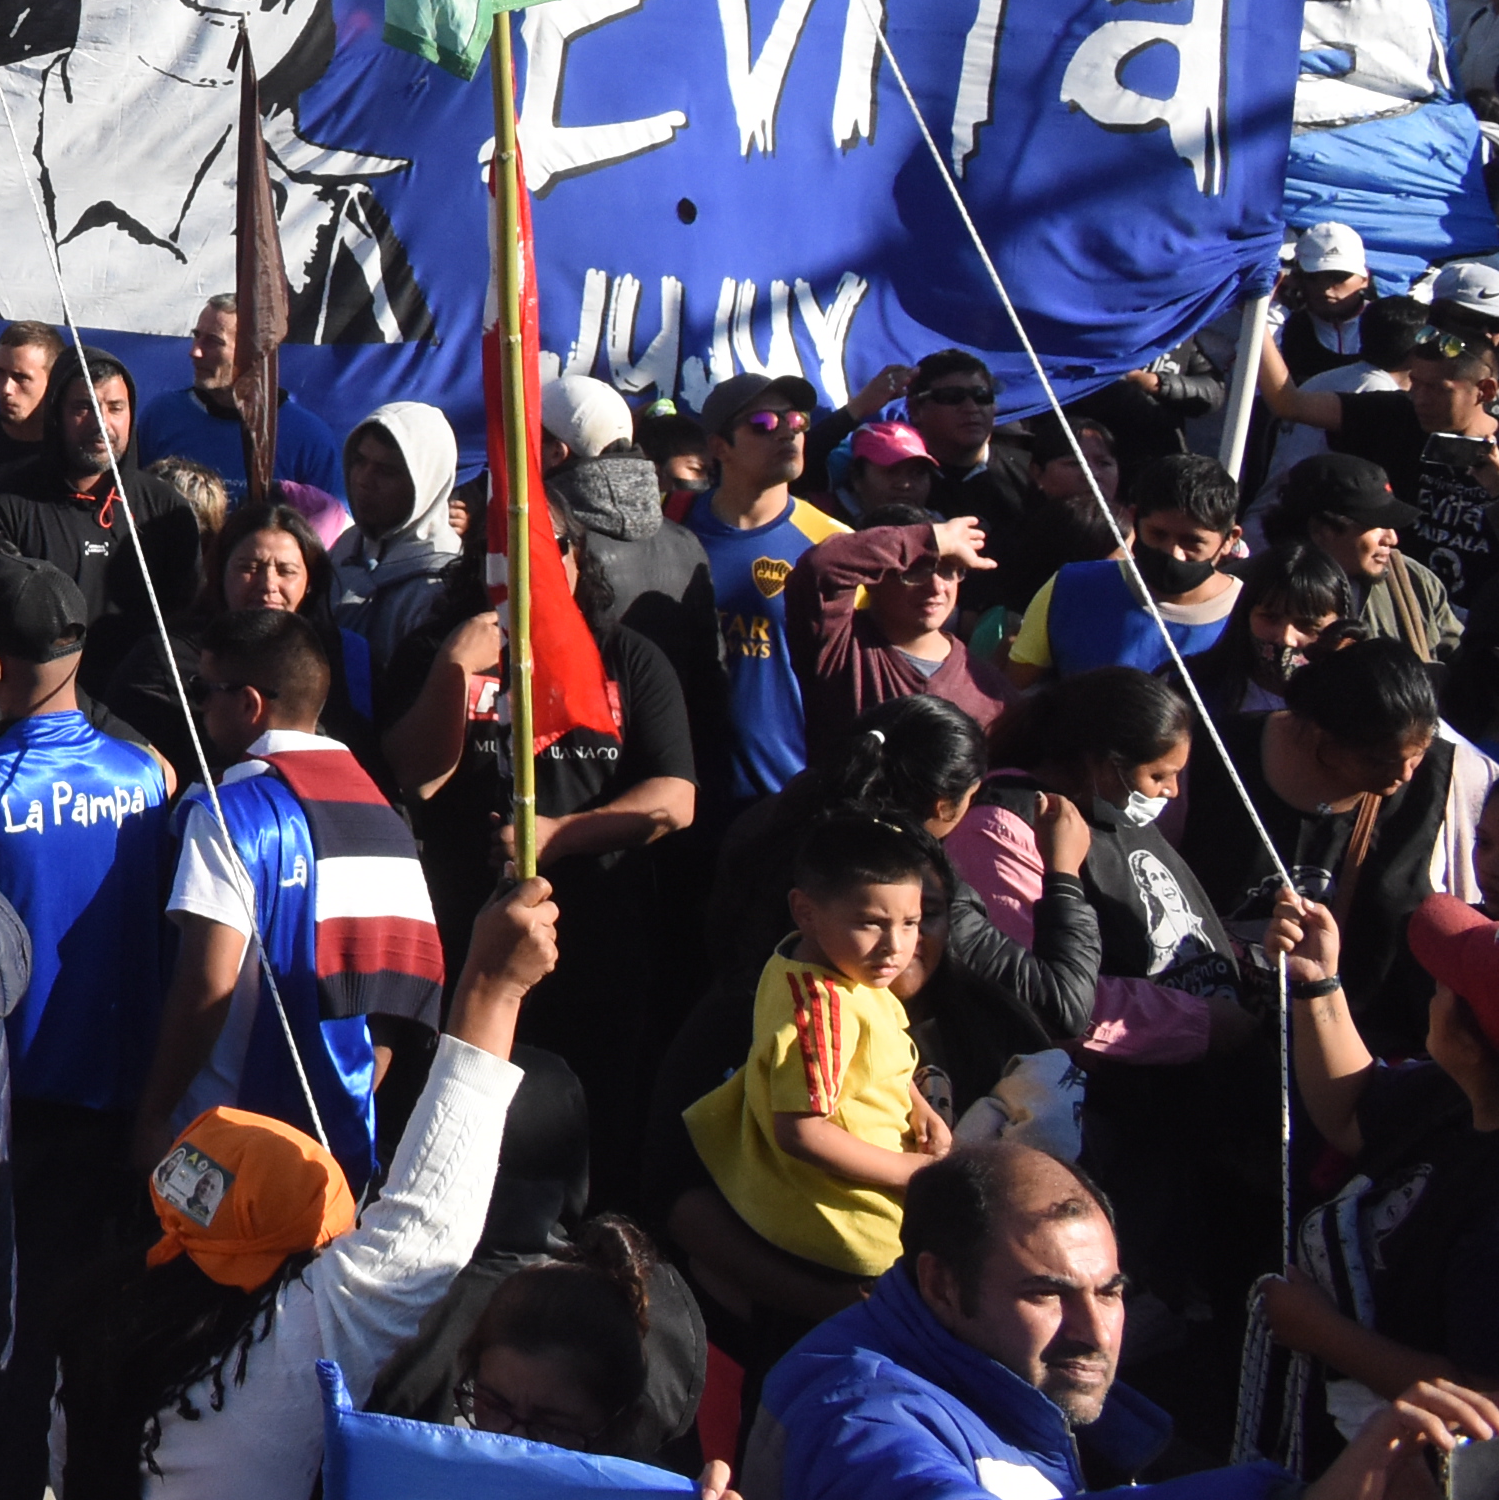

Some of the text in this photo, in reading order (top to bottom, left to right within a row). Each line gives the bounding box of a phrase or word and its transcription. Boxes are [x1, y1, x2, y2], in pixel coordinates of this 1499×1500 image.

[1418, 488, 1483, 532] Evita
[2, 781, 145, 834] La Pampa
